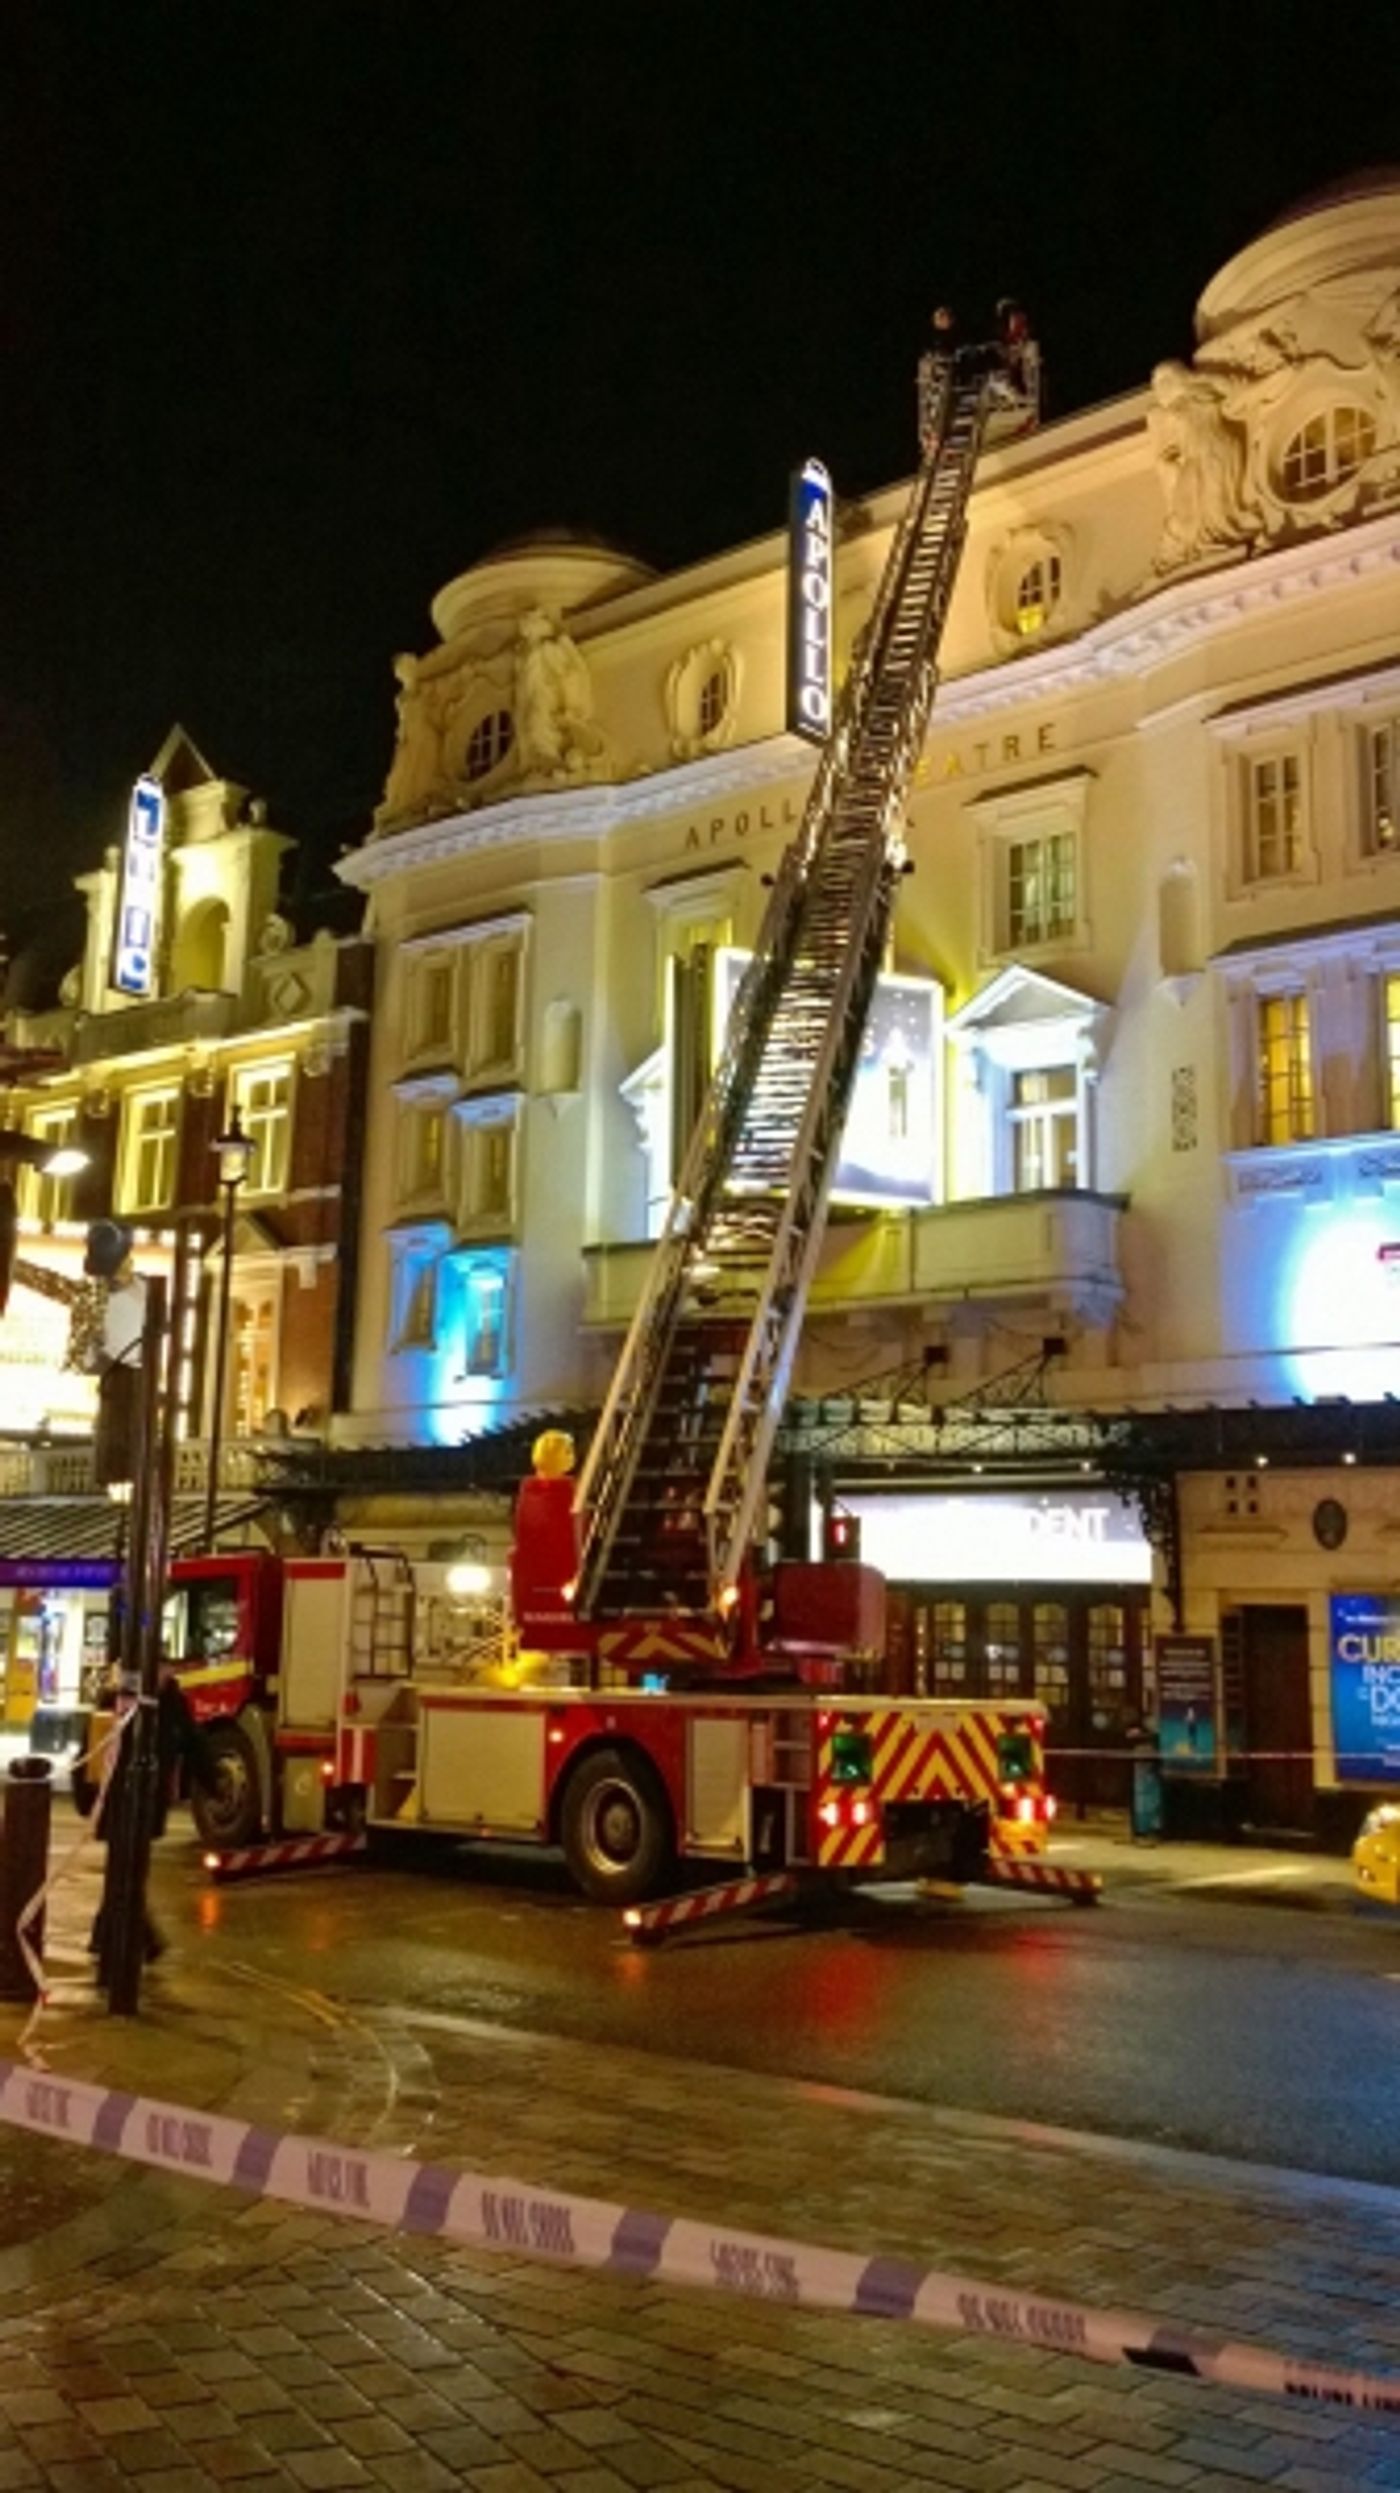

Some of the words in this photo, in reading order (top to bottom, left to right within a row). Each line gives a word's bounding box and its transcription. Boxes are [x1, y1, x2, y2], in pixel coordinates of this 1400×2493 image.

[802, 499, 829, 721] APOLLO
[685, 801, 798, 849] APOLL
[913, 723, 1056, 788] EATRE
